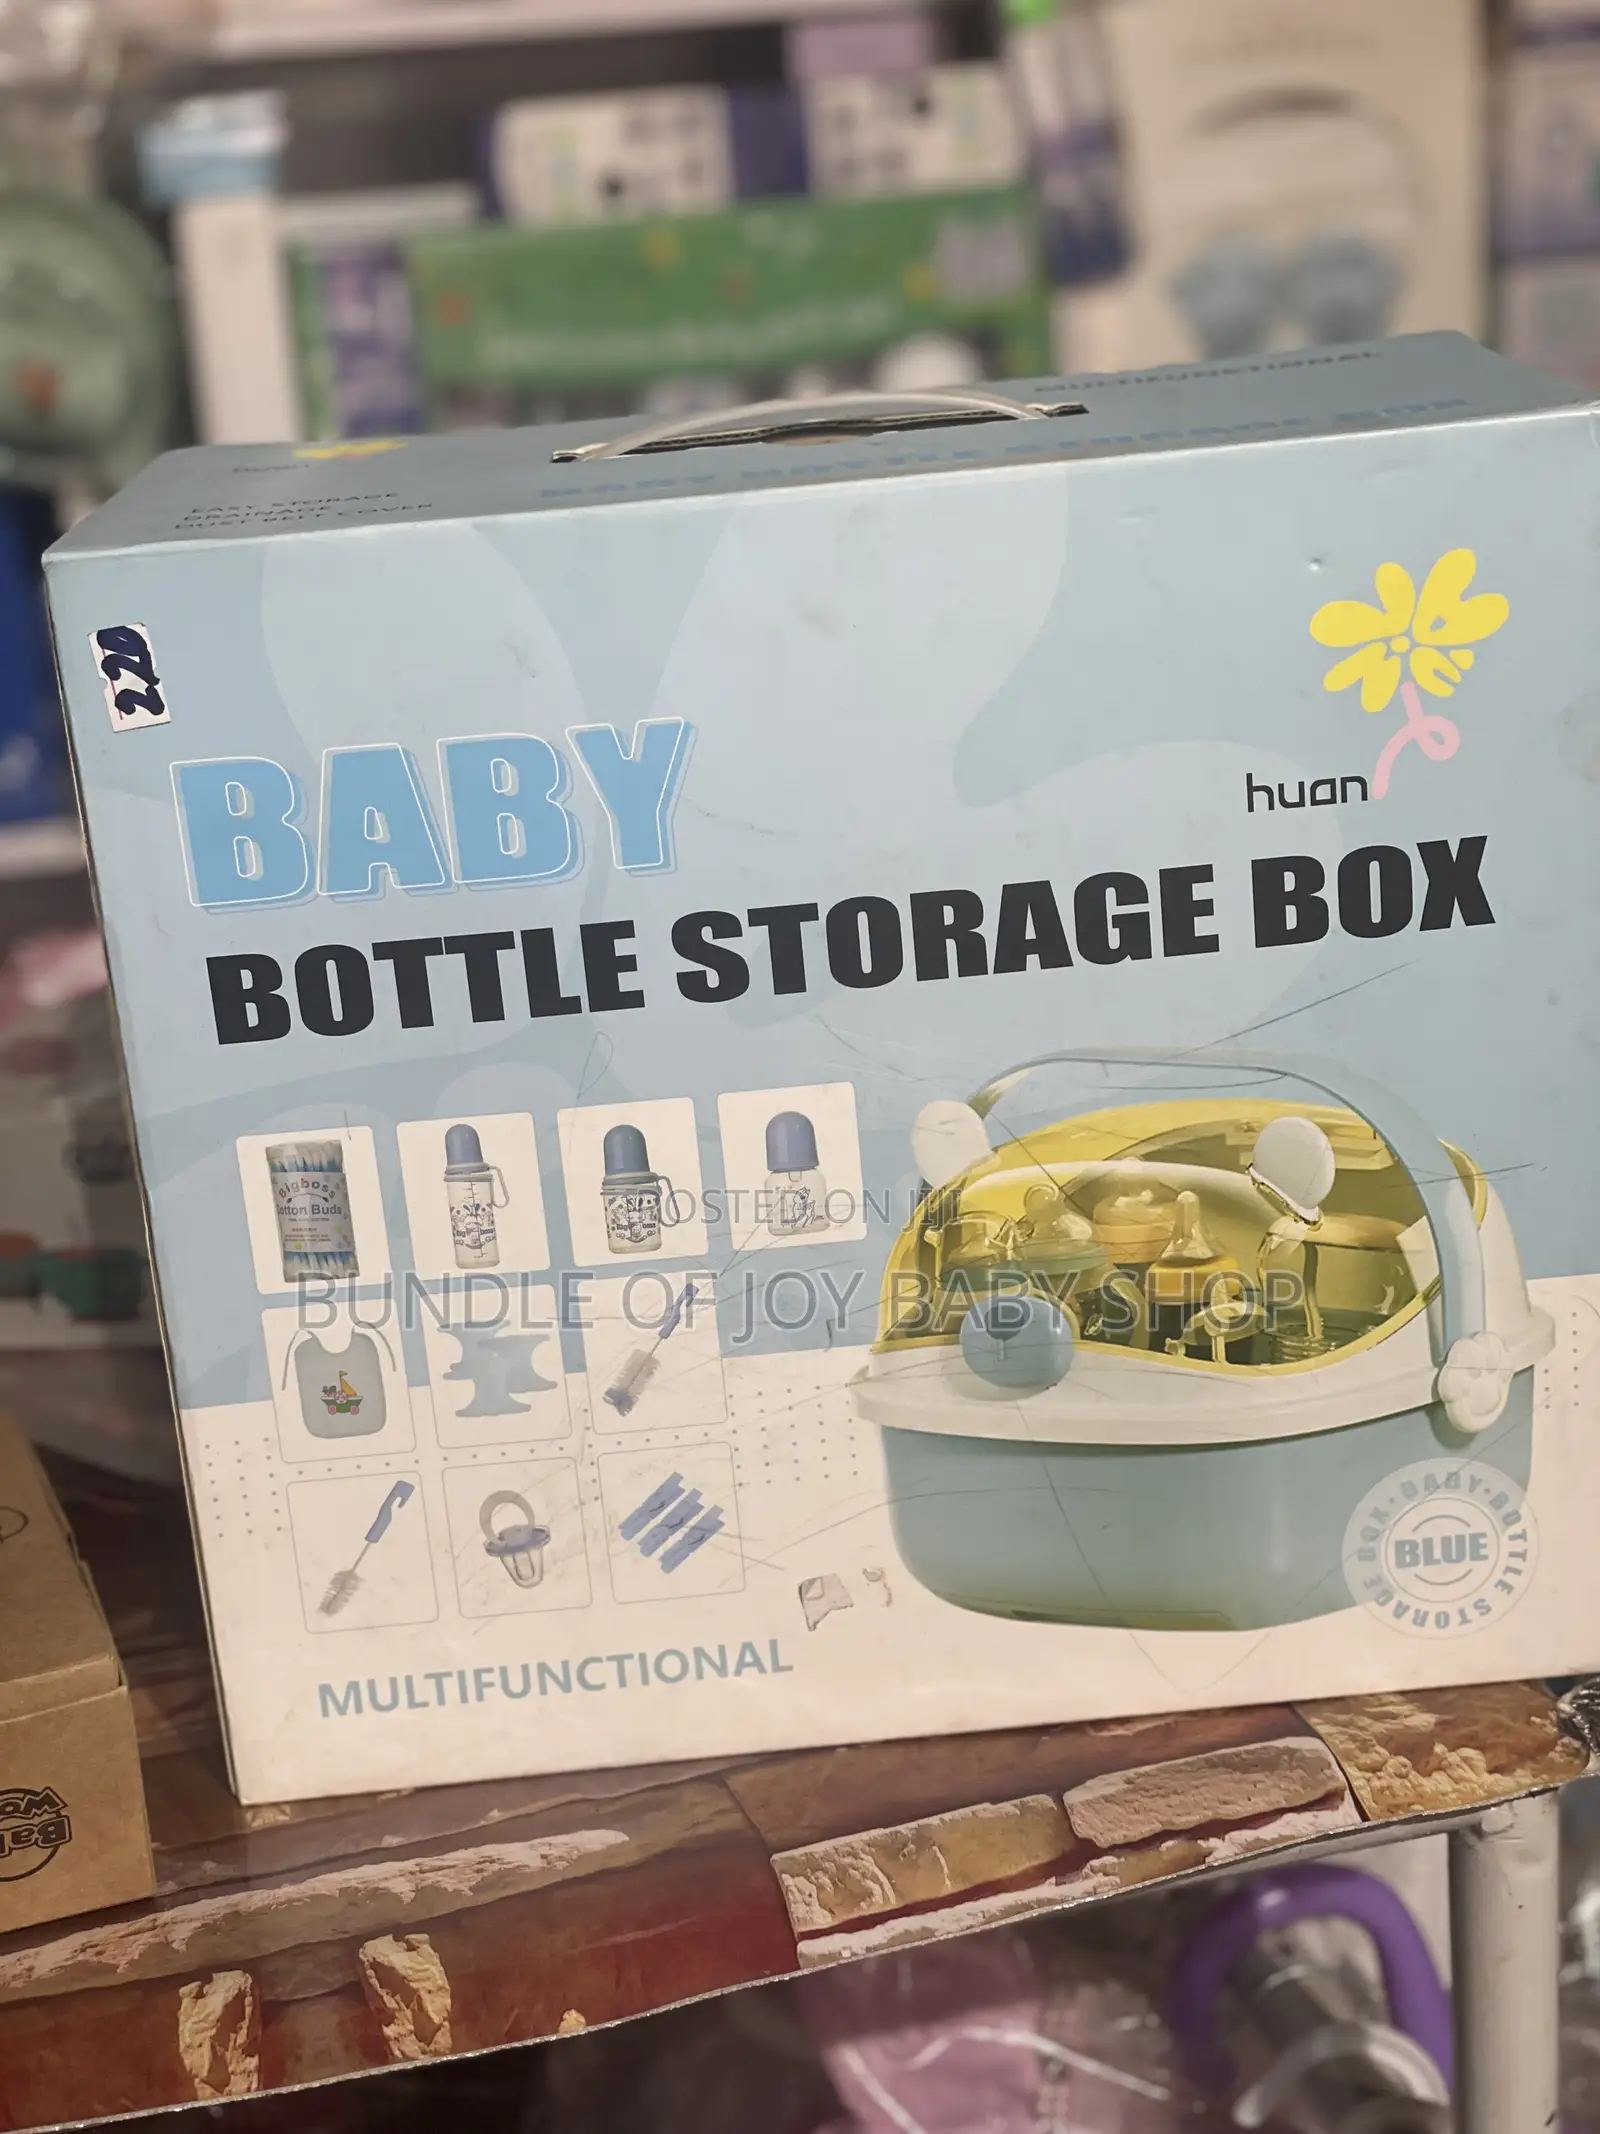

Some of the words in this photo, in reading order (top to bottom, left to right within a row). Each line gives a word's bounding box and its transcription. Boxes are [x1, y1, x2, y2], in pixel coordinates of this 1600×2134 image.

[169, 717, 698, 914] BABY
[1246, 772, 1368, 813] huan
[205, 920, 645, 1045] BOTTLE
[670, 863, 1221, 1005] STORAGE
[1250, 835, 1497, 949] BOX
[311, 1203, 342, 1215] Buds
[1394, 1532, 1489, 1569] BLUE
[1400, 1471, 1484, 1500] BABY
[1488, 1491, 1528, 1596] BOTTLE
[318, 1638, 794, 1718] MULTIFUNCTIONAL
